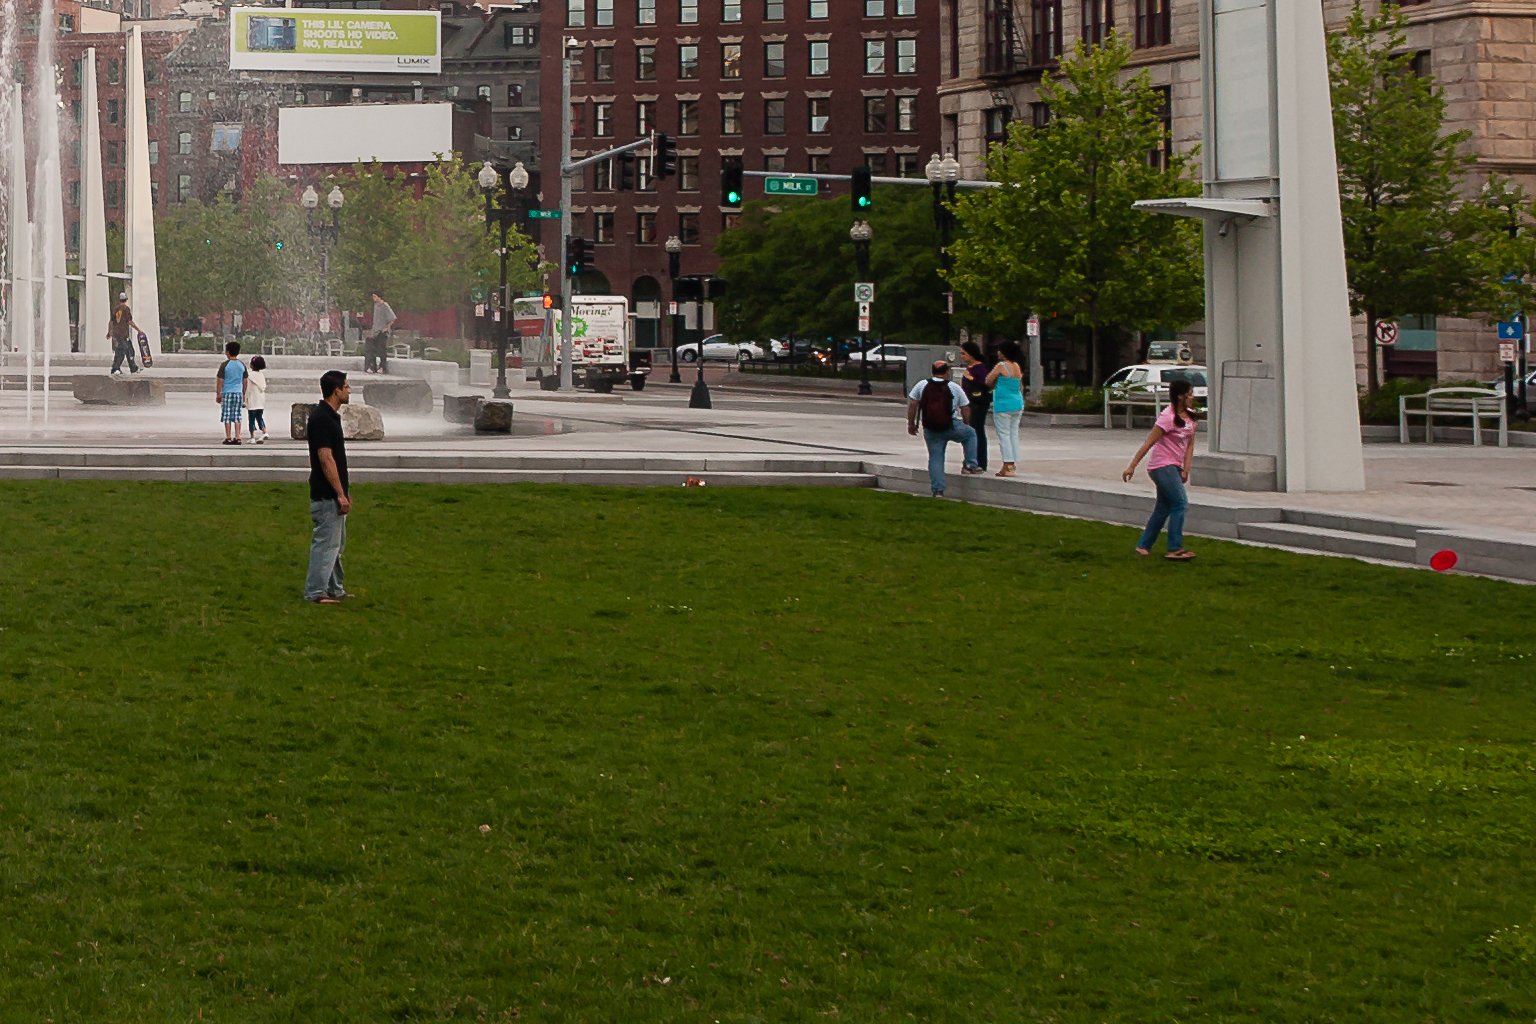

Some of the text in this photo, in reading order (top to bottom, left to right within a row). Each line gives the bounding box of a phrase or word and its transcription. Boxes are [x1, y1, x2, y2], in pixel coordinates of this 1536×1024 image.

[302, 20, 392, 30] THIS LIL' CAMERA
[303, 30, 399, 40] SHOOTS HD VIDEO.
[303, 39, 363, 49] NO, REALLY.
[783, 181, 802, 191] MILK
